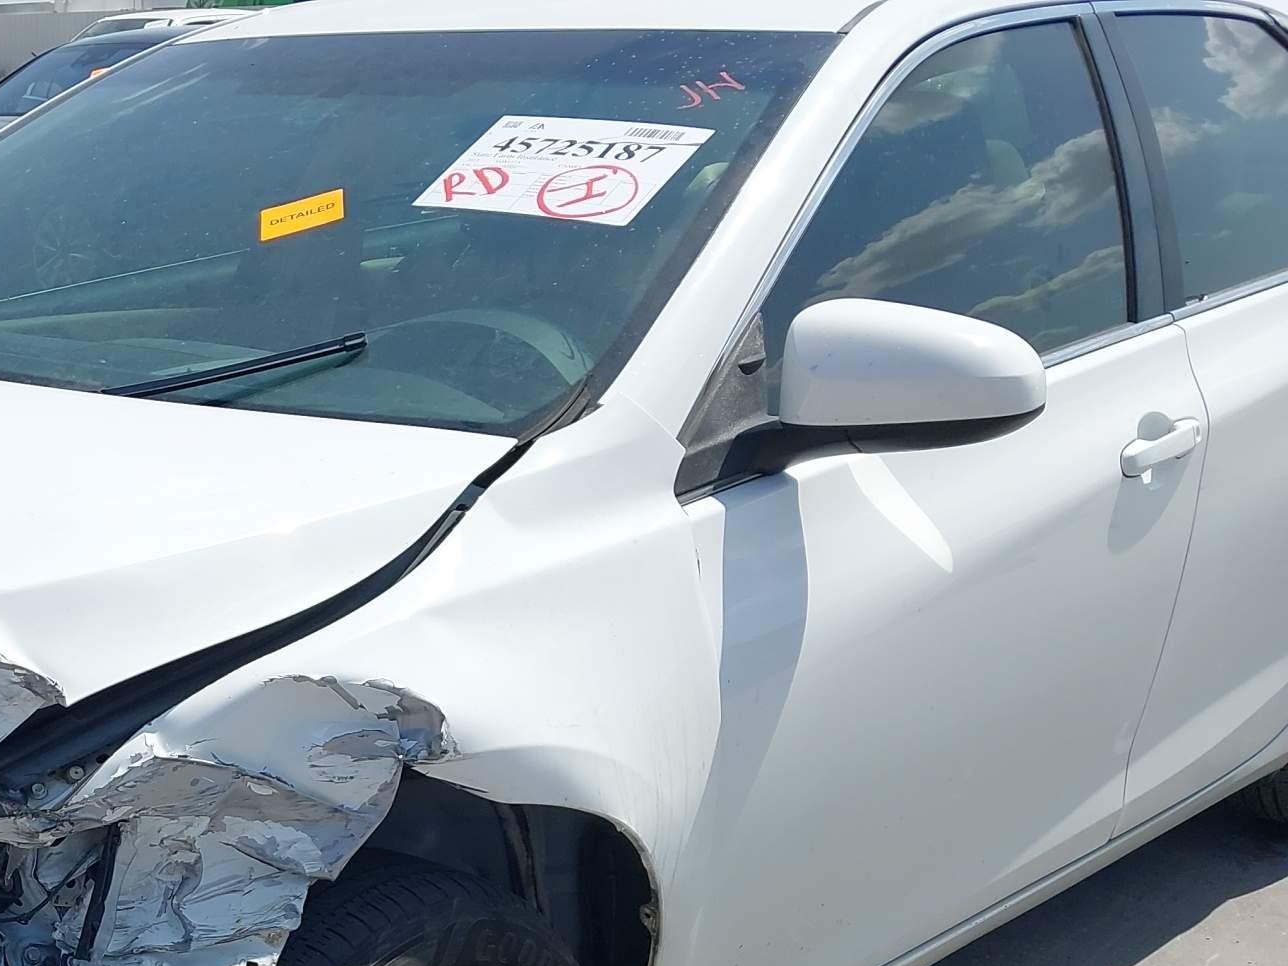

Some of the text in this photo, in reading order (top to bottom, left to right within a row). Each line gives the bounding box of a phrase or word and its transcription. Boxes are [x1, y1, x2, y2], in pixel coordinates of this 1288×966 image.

[493, 136, 668, 164] 45725187
[443, 166, 510, 202] RD
[269, 202, 336, 226] DETAILED
